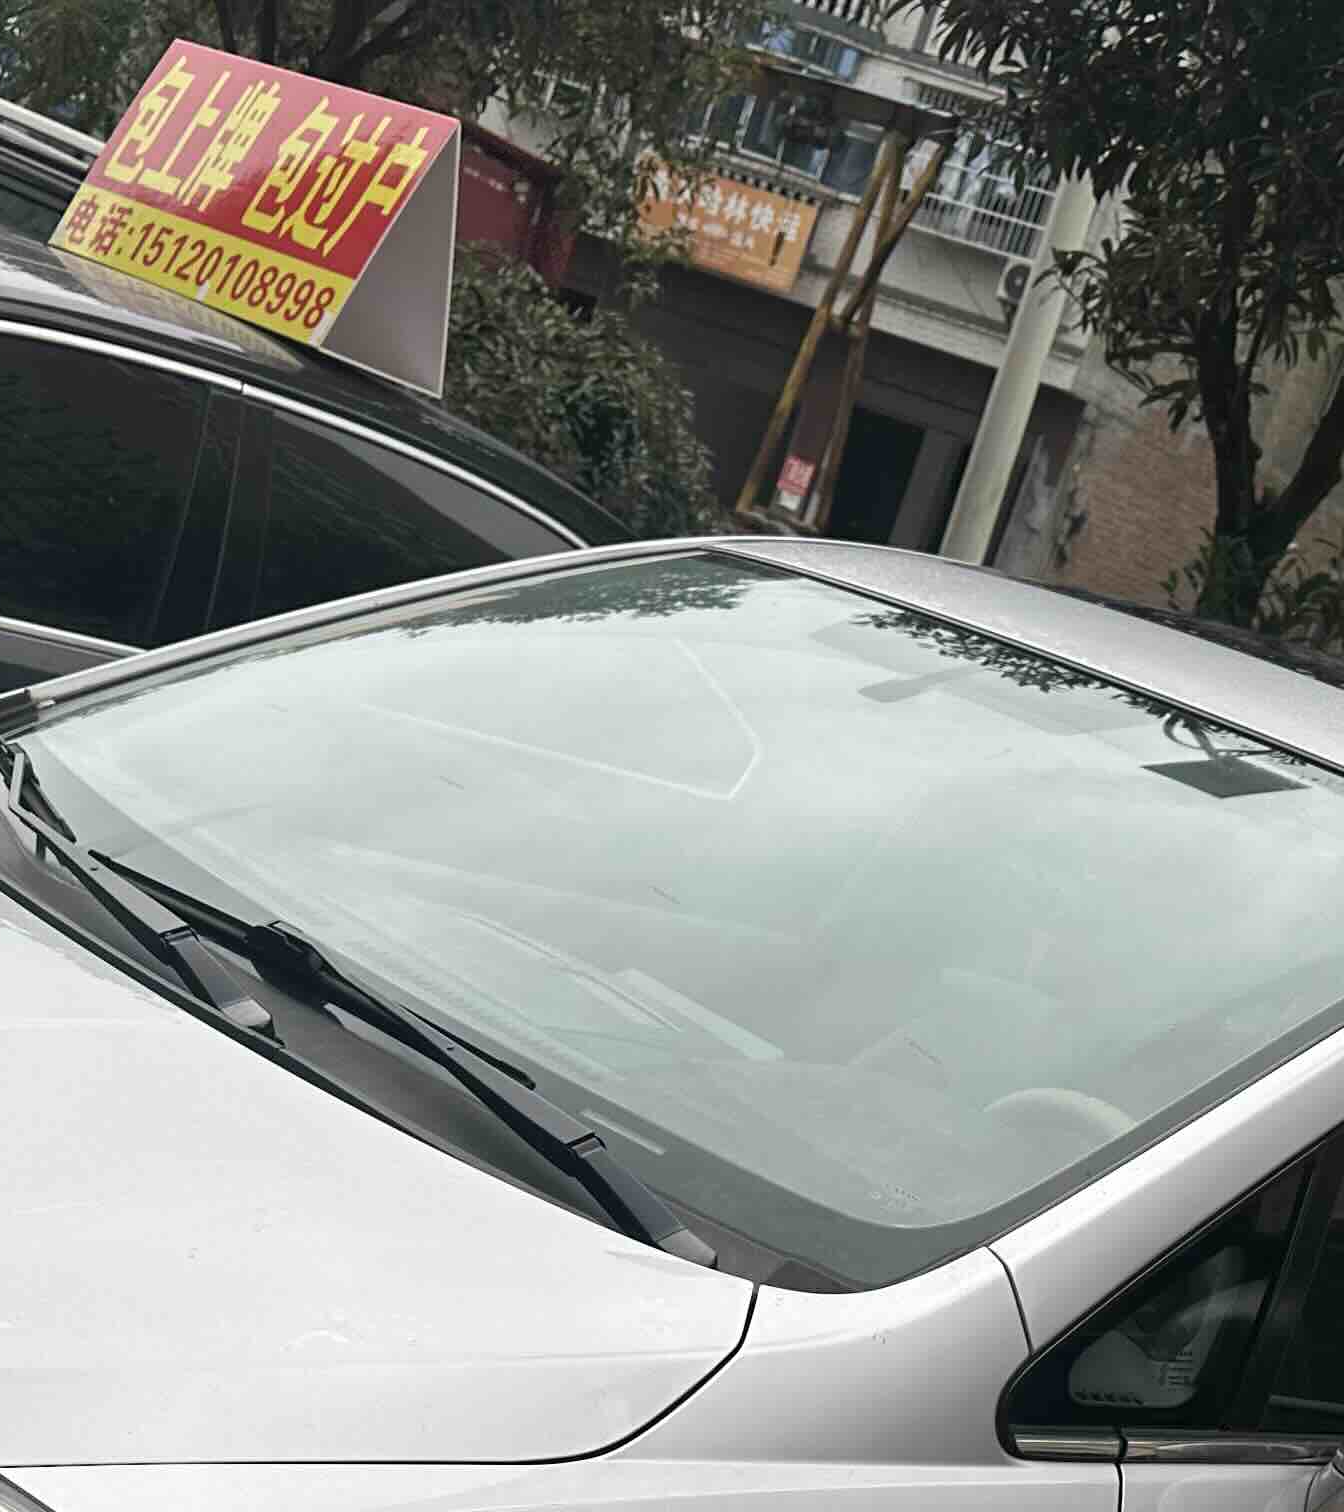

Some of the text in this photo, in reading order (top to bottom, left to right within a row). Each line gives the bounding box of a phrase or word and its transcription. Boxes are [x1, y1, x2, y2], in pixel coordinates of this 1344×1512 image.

[103, 55, 429, 258] 包上牌 包过户
